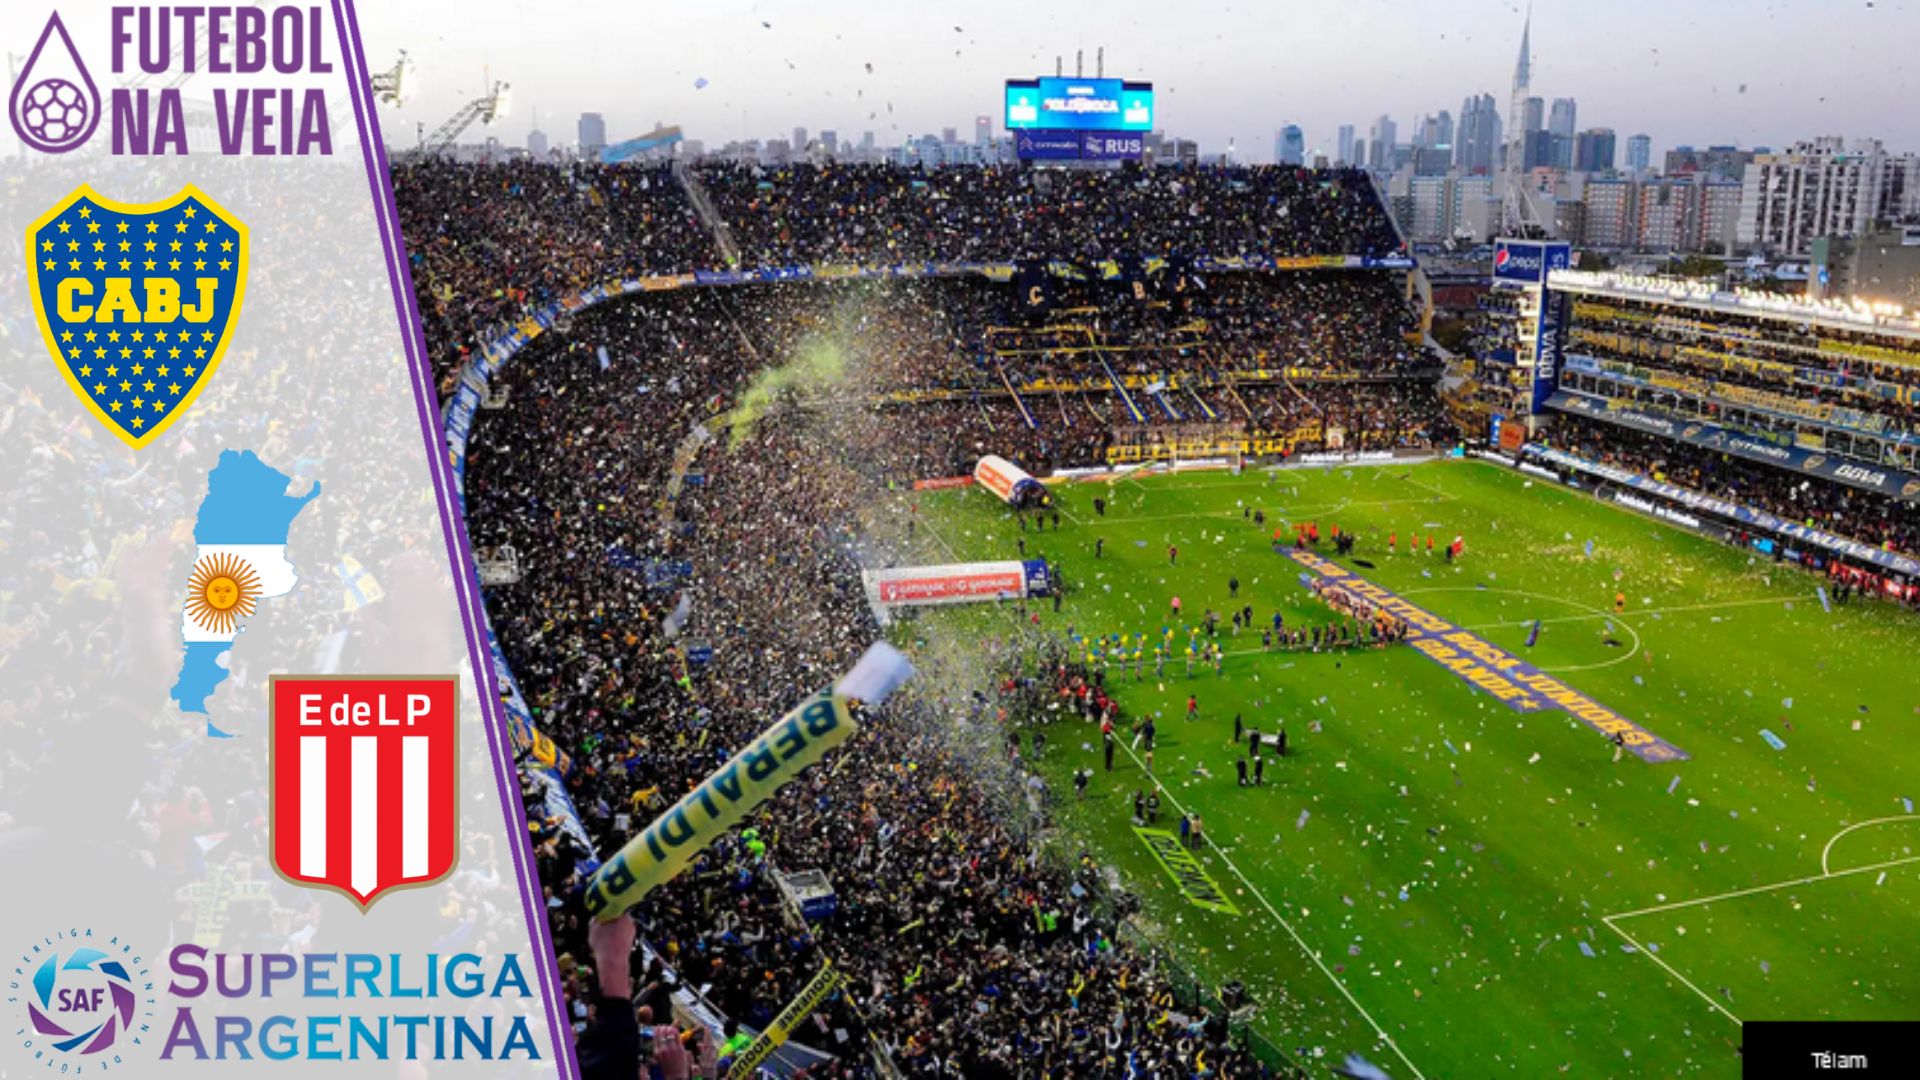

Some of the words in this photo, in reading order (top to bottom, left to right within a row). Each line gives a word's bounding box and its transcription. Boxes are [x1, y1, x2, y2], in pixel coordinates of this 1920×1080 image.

[1105, 139, 1141, 153] RUS
[1515, 671, 1656, 746] JUNIORS
[646, 697, 840, 862] BERALDI
